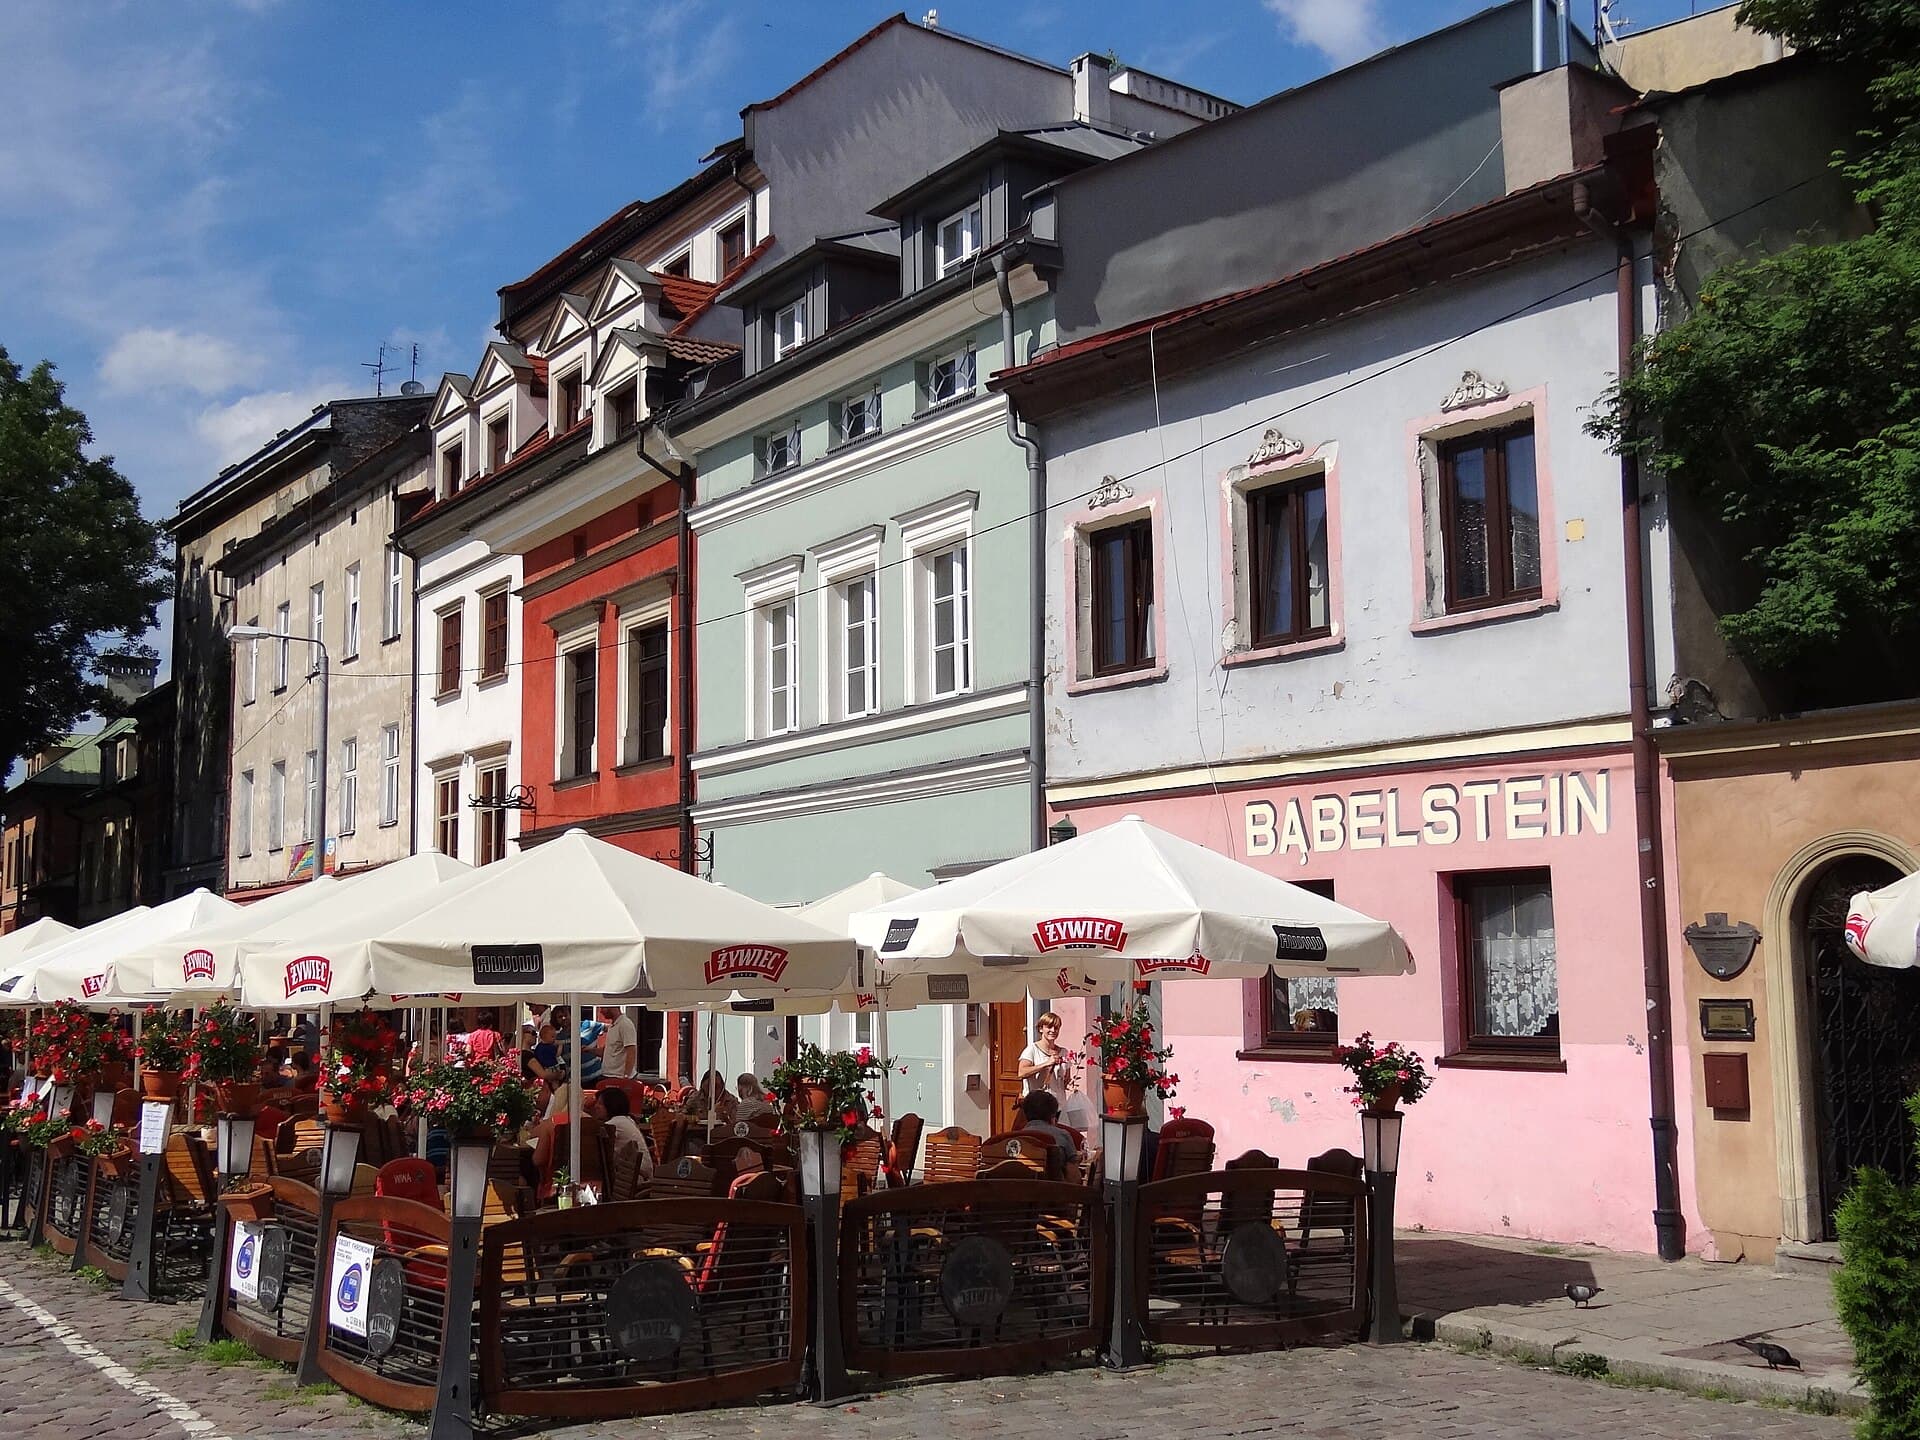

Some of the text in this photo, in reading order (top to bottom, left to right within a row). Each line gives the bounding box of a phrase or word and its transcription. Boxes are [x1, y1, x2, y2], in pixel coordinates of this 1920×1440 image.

[1044, 919, 1117, 943] ŻYWIEC
[187, 952, 214, 973] ŻYWIEC
[716, 948, 783, 972] ŻYWIEC
[290, 960, 330, 985] ŻYWIEC
